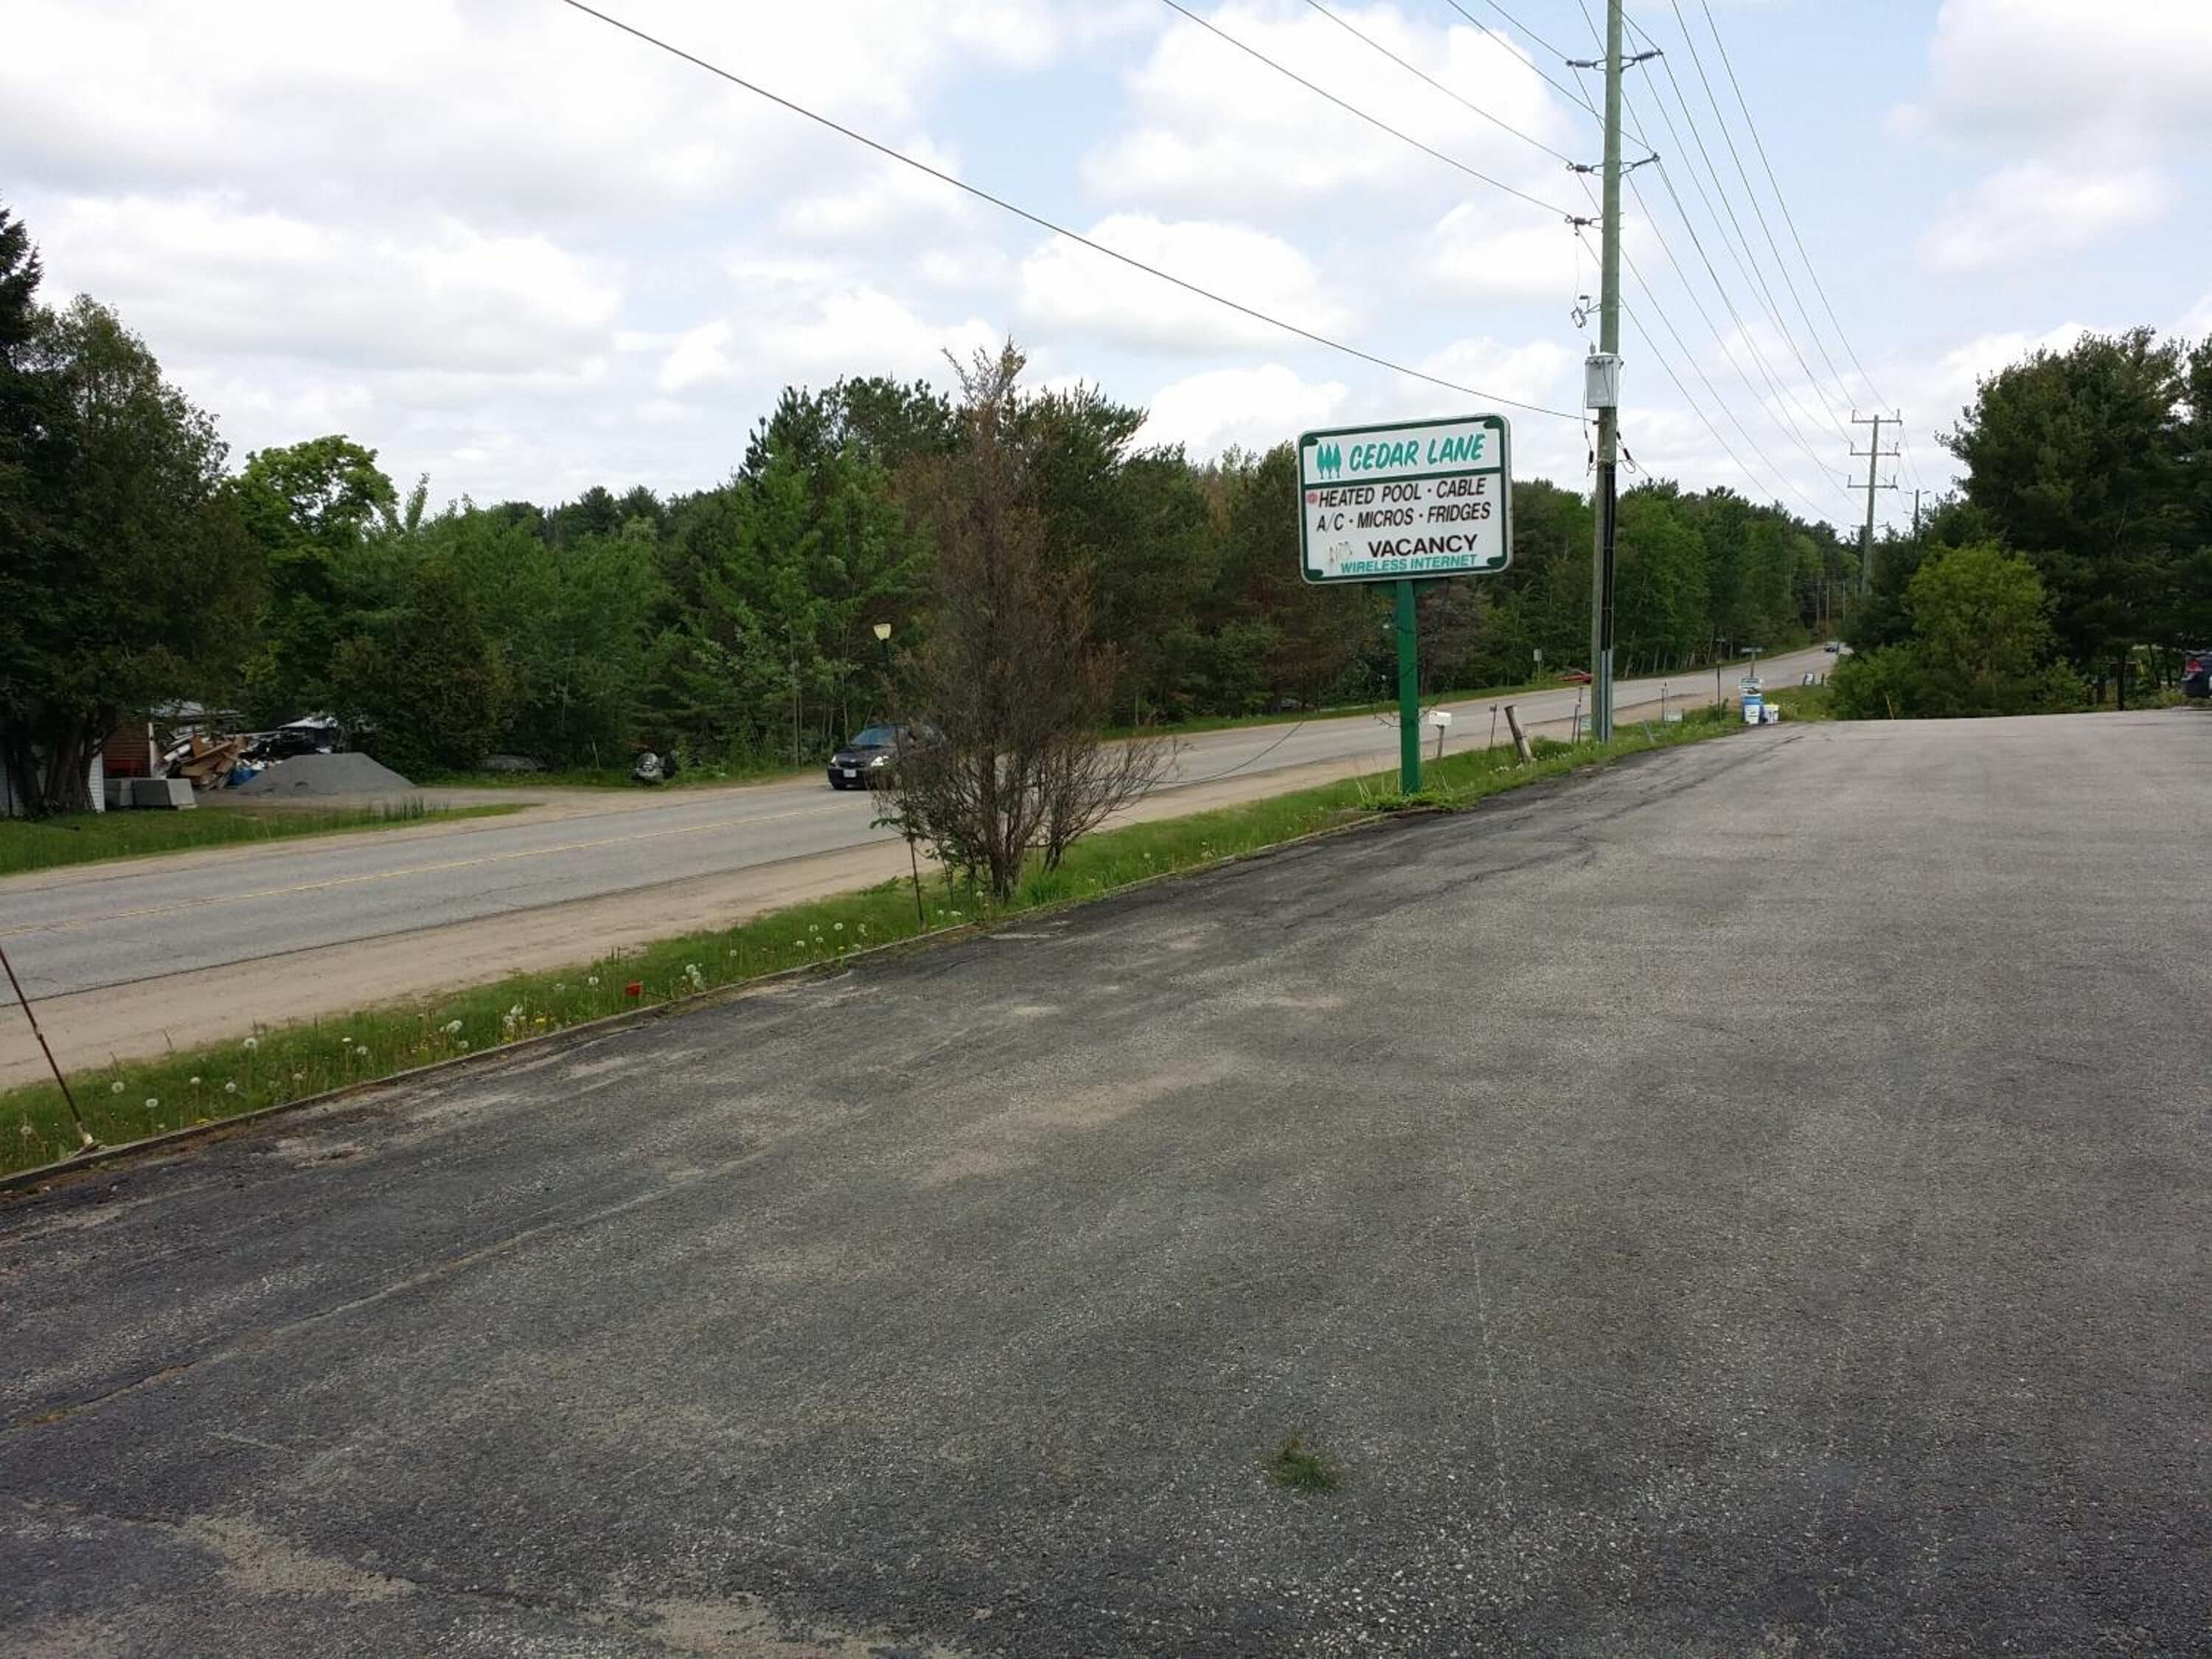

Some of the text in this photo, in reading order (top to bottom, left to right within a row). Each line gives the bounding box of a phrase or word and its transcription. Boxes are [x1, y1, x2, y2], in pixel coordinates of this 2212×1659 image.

[1349, 433, 1486, 472] CEDAR LANE
[1318, 477, 1486, 508] HEATED POOL CABLE
[1316, 501, 1491, 532] A/C MICROS FRIDGES
[1368, 533, 1478, 557] VACANCY
[1340, 554, 1478, 574] WIRELESS INTERNET
